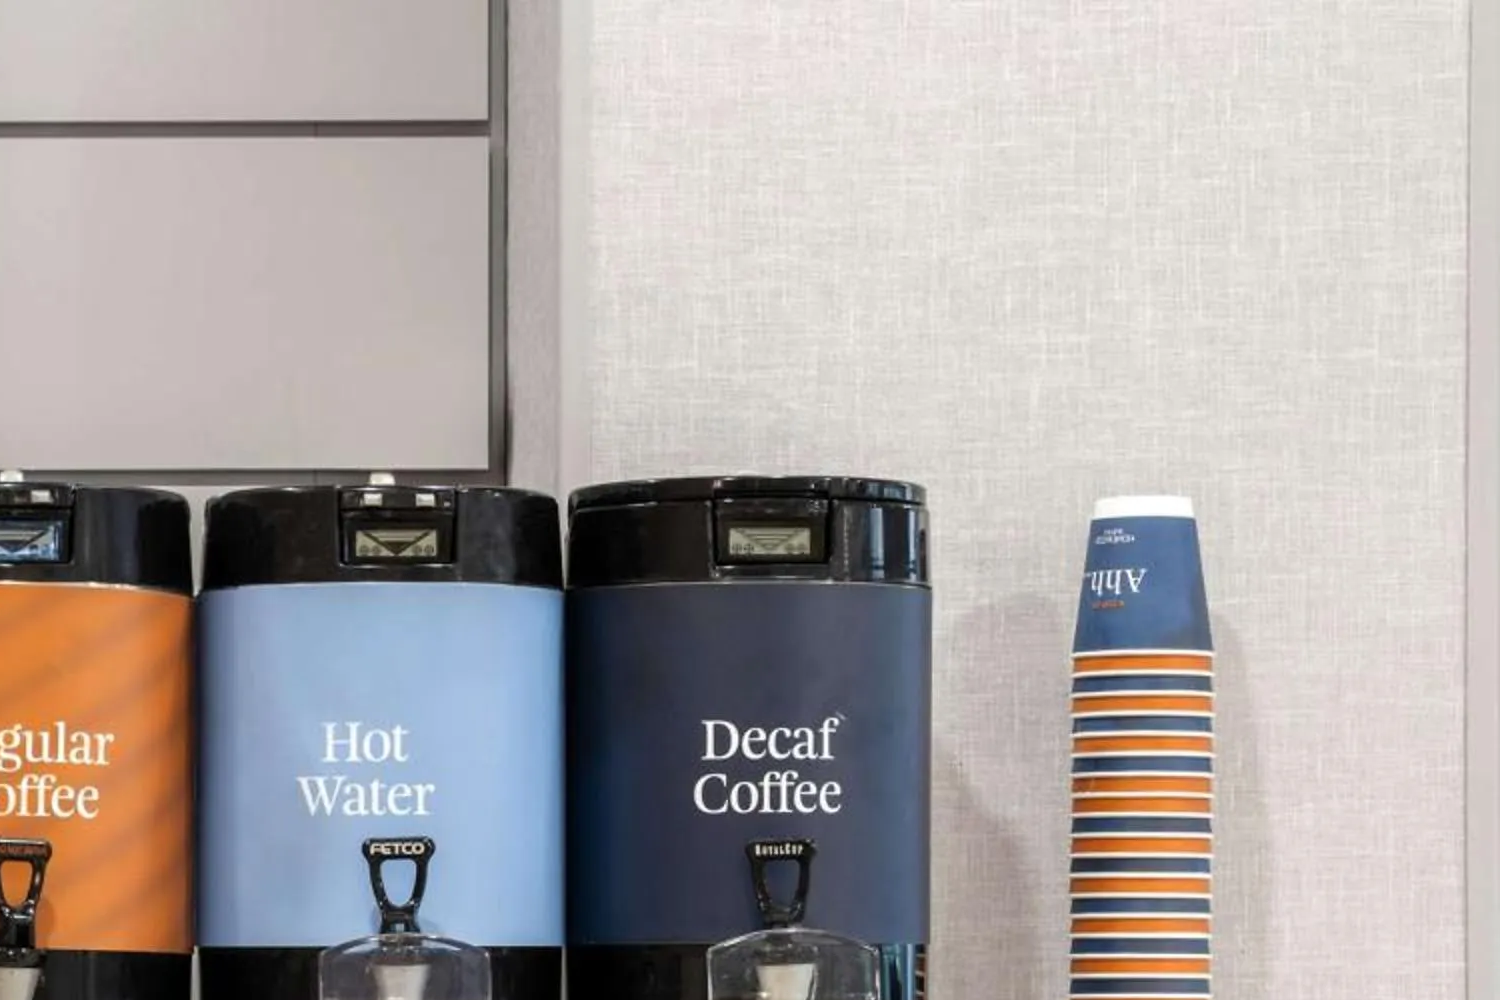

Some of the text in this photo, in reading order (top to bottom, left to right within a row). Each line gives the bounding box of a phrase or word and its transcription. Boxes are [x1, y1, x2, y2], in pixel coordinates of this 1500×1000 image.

[321, 721, 409, 763] Hot
[701, 717, 840, 761] Decaf
[297, 776, 435, 817] Water
[693, 770, 842, 815] Coffee
[370, 842, 425, 855] FETCO
